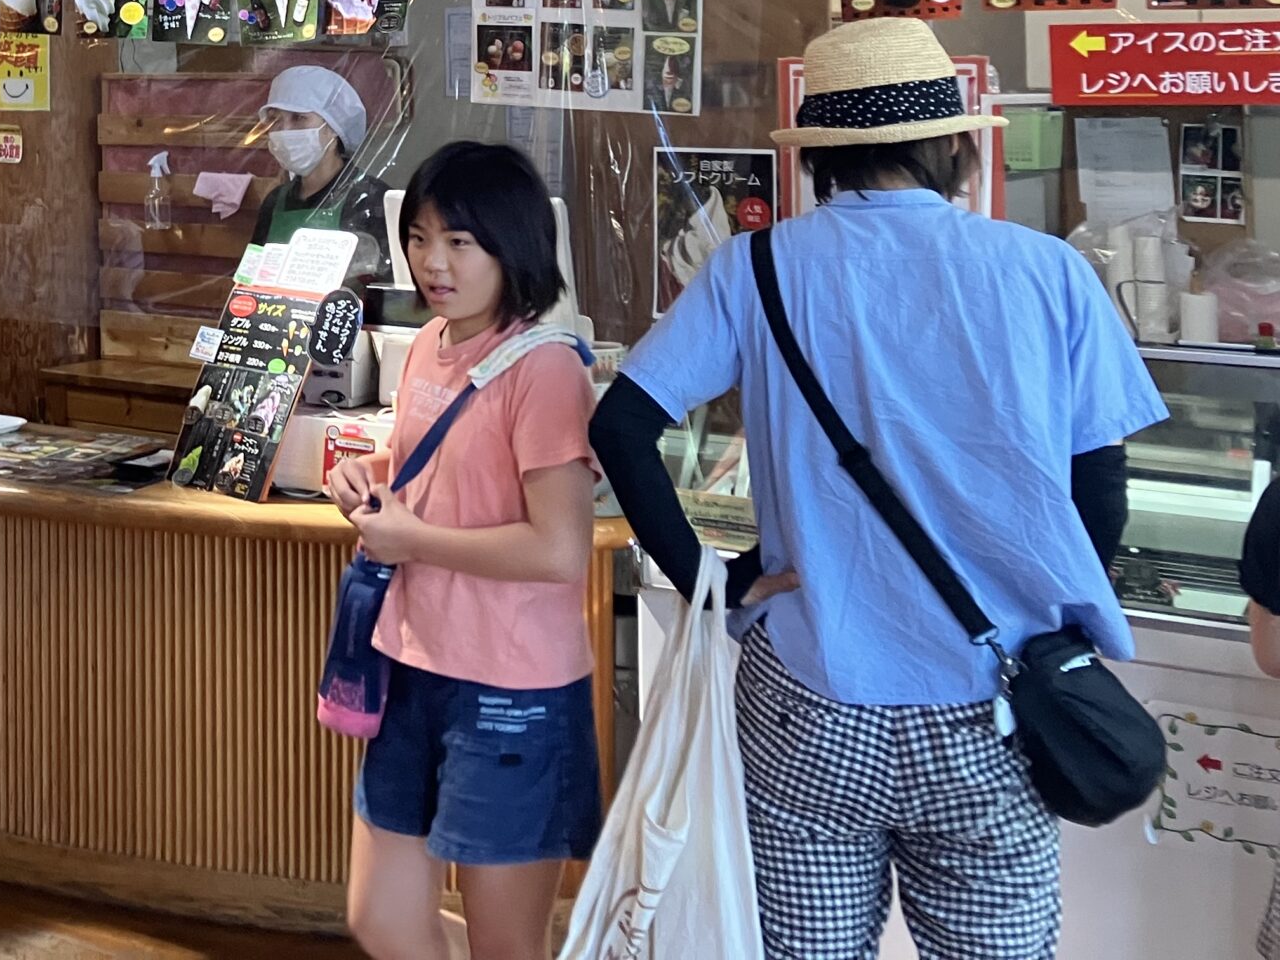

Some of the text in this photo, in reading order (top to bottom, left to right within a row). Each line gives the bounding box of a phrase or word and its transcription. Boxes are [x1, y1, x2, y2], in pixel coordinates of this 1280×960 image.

[1109, 29, 1280, 54] アイスのご注
[700, 160, 734, 171] 自家製
[672, 171, 760, 185] ソフトクリーム
[257, 303, 286, 317] サイズ
[231, 318, 251, 328] ダブル
[222, 334, 249, 347] シングル
